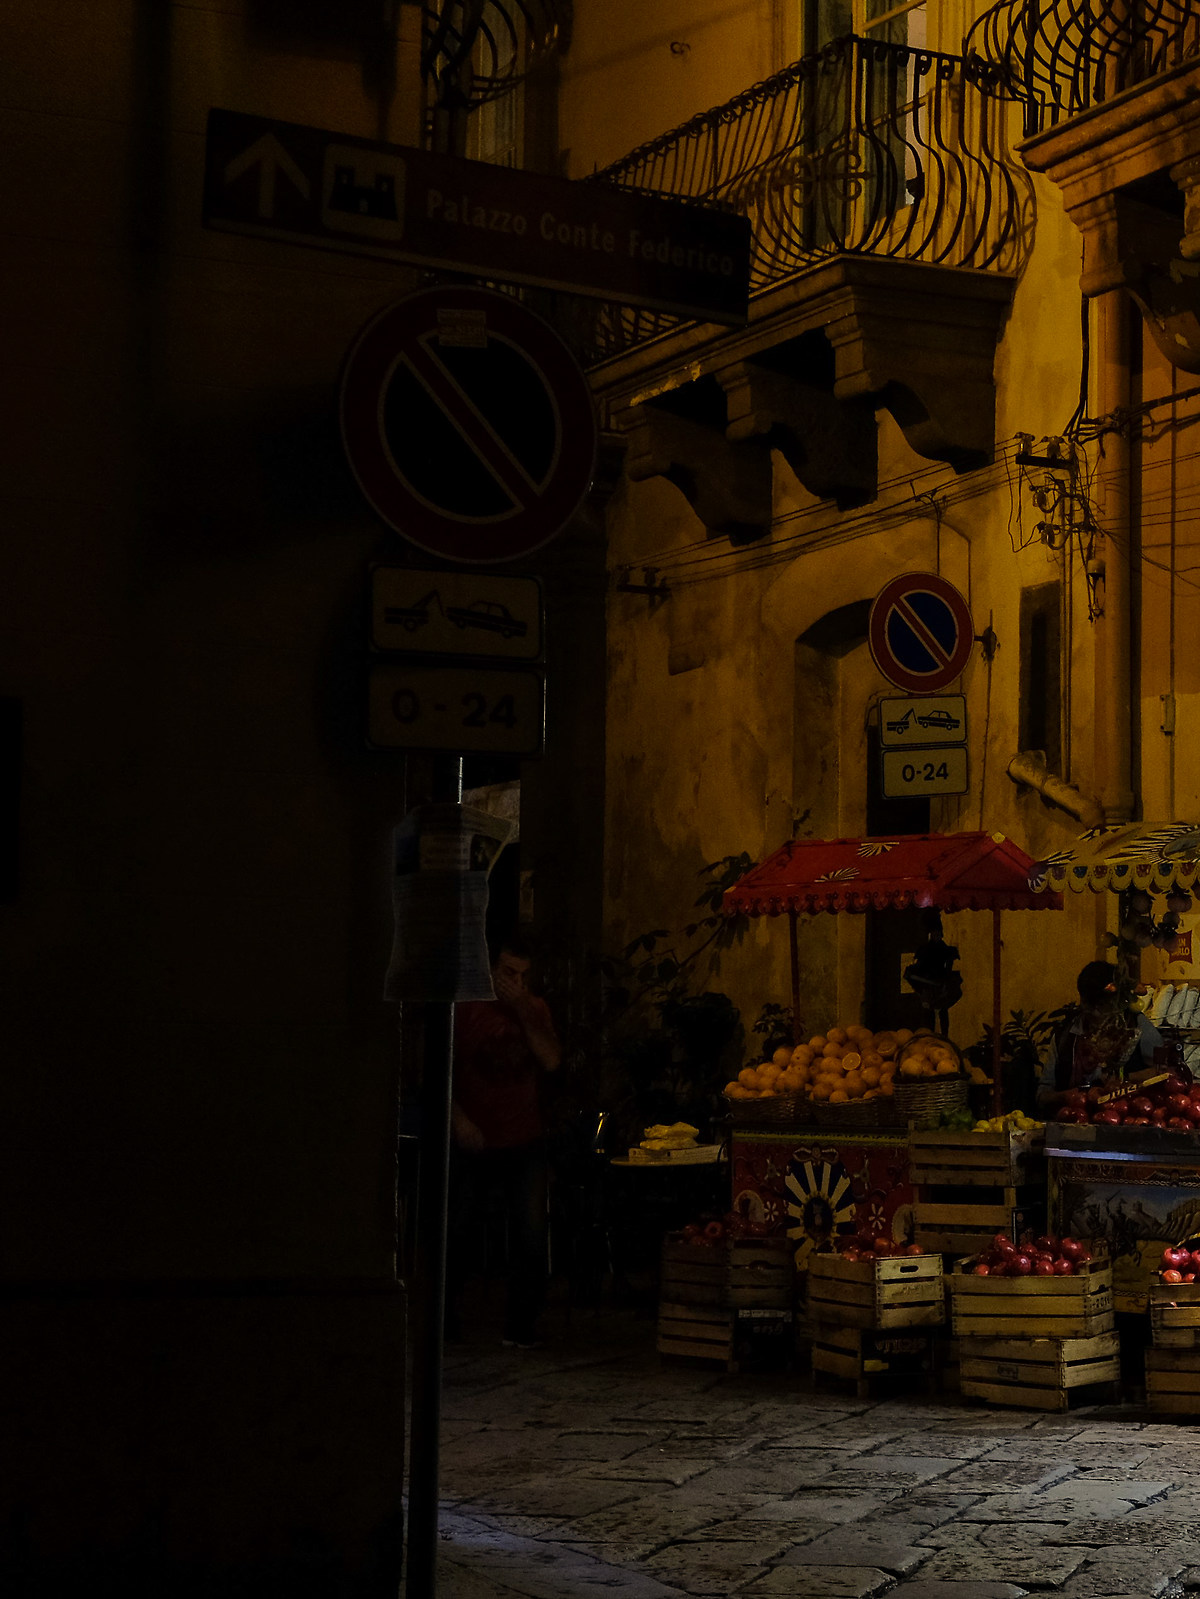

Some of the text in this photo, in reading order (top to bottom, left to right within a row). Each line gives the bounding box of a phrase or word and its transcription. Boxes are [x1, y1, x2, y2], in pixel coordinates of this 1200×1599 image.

[426, 189, 735, 279] Palazzo Conte Federico
[902, 762, 949, 783] 0-24
